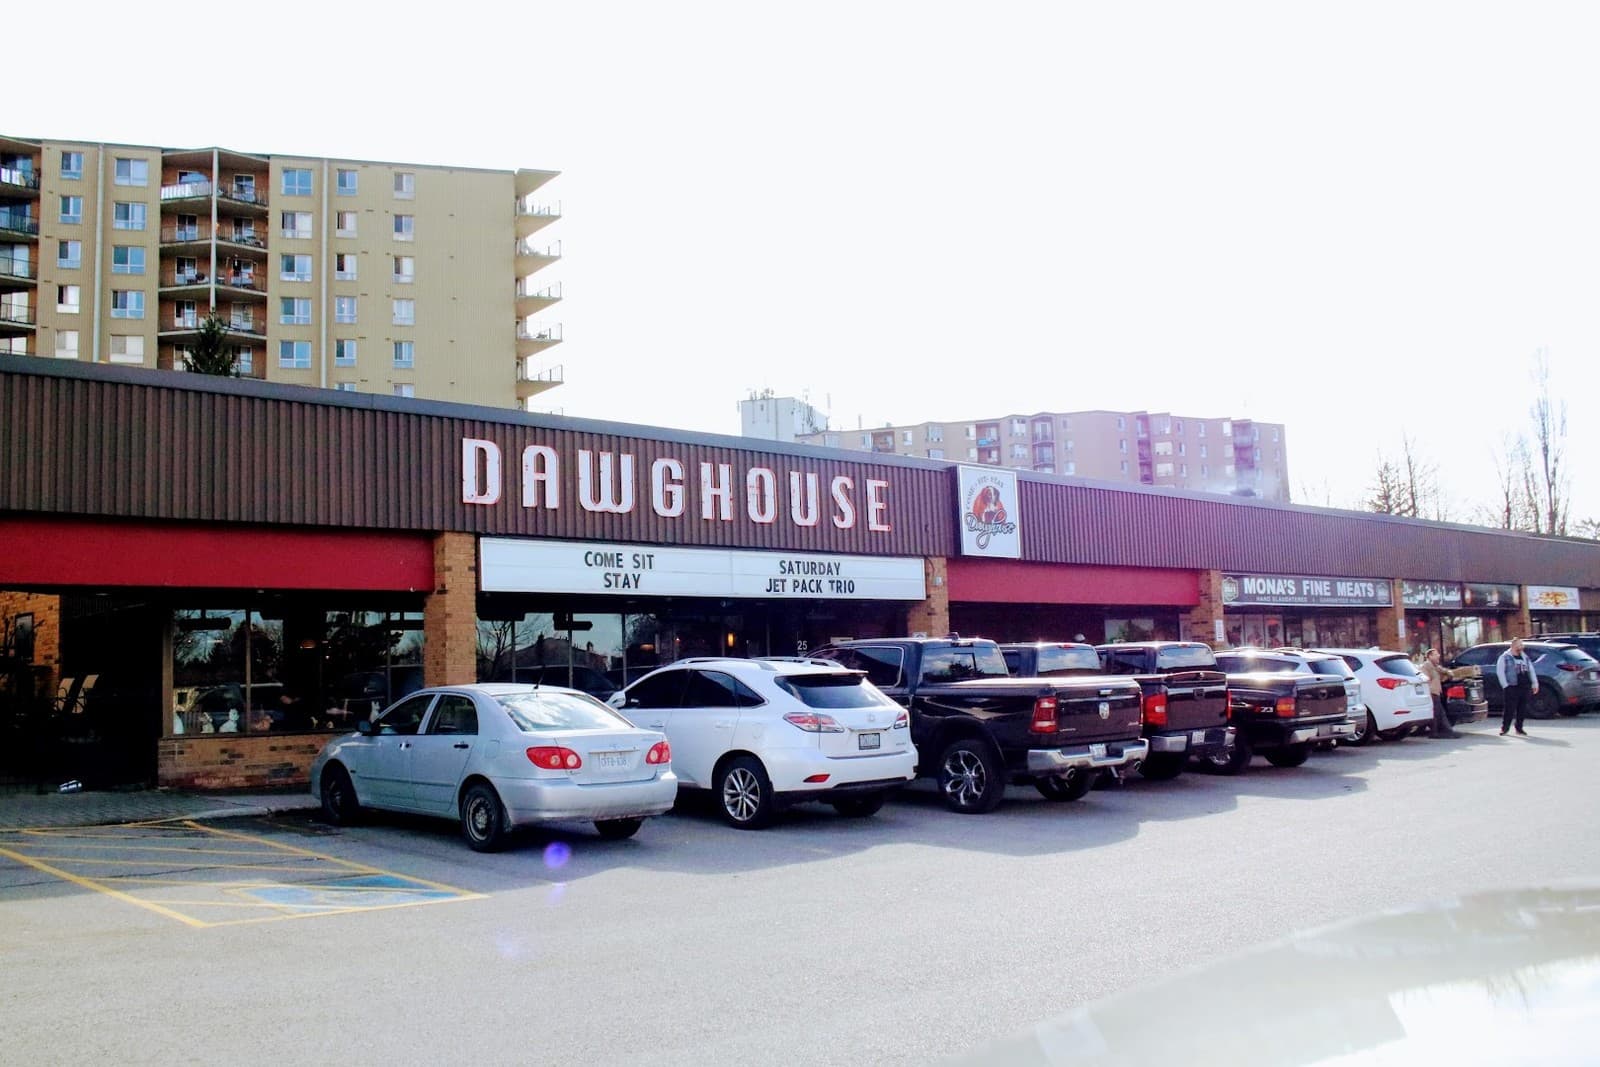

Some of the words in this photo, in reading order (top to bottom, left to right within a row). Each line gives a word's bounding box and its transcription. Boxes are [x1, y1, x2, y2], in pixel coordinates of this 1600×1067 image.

[462, 437, 891, 532] DAWGHOUSE
[584, 551, 624, 568] COME
[632, 554, 654, 570] SIT
[779, 560, 841, 576] SATURDAY
[603, 572, 641, 589] STAY
[765, 577, 788, 593] JET
[792, 578, 823, 594] PACK
[828, 579, 855, 594] TRIO
[1243, 578, 1296, 596] MONA'S
[1302, 580, 1331, 597] FINE
[1336, 582, 1375, 598] MEATS
[797, 640, 808, 650] 25
